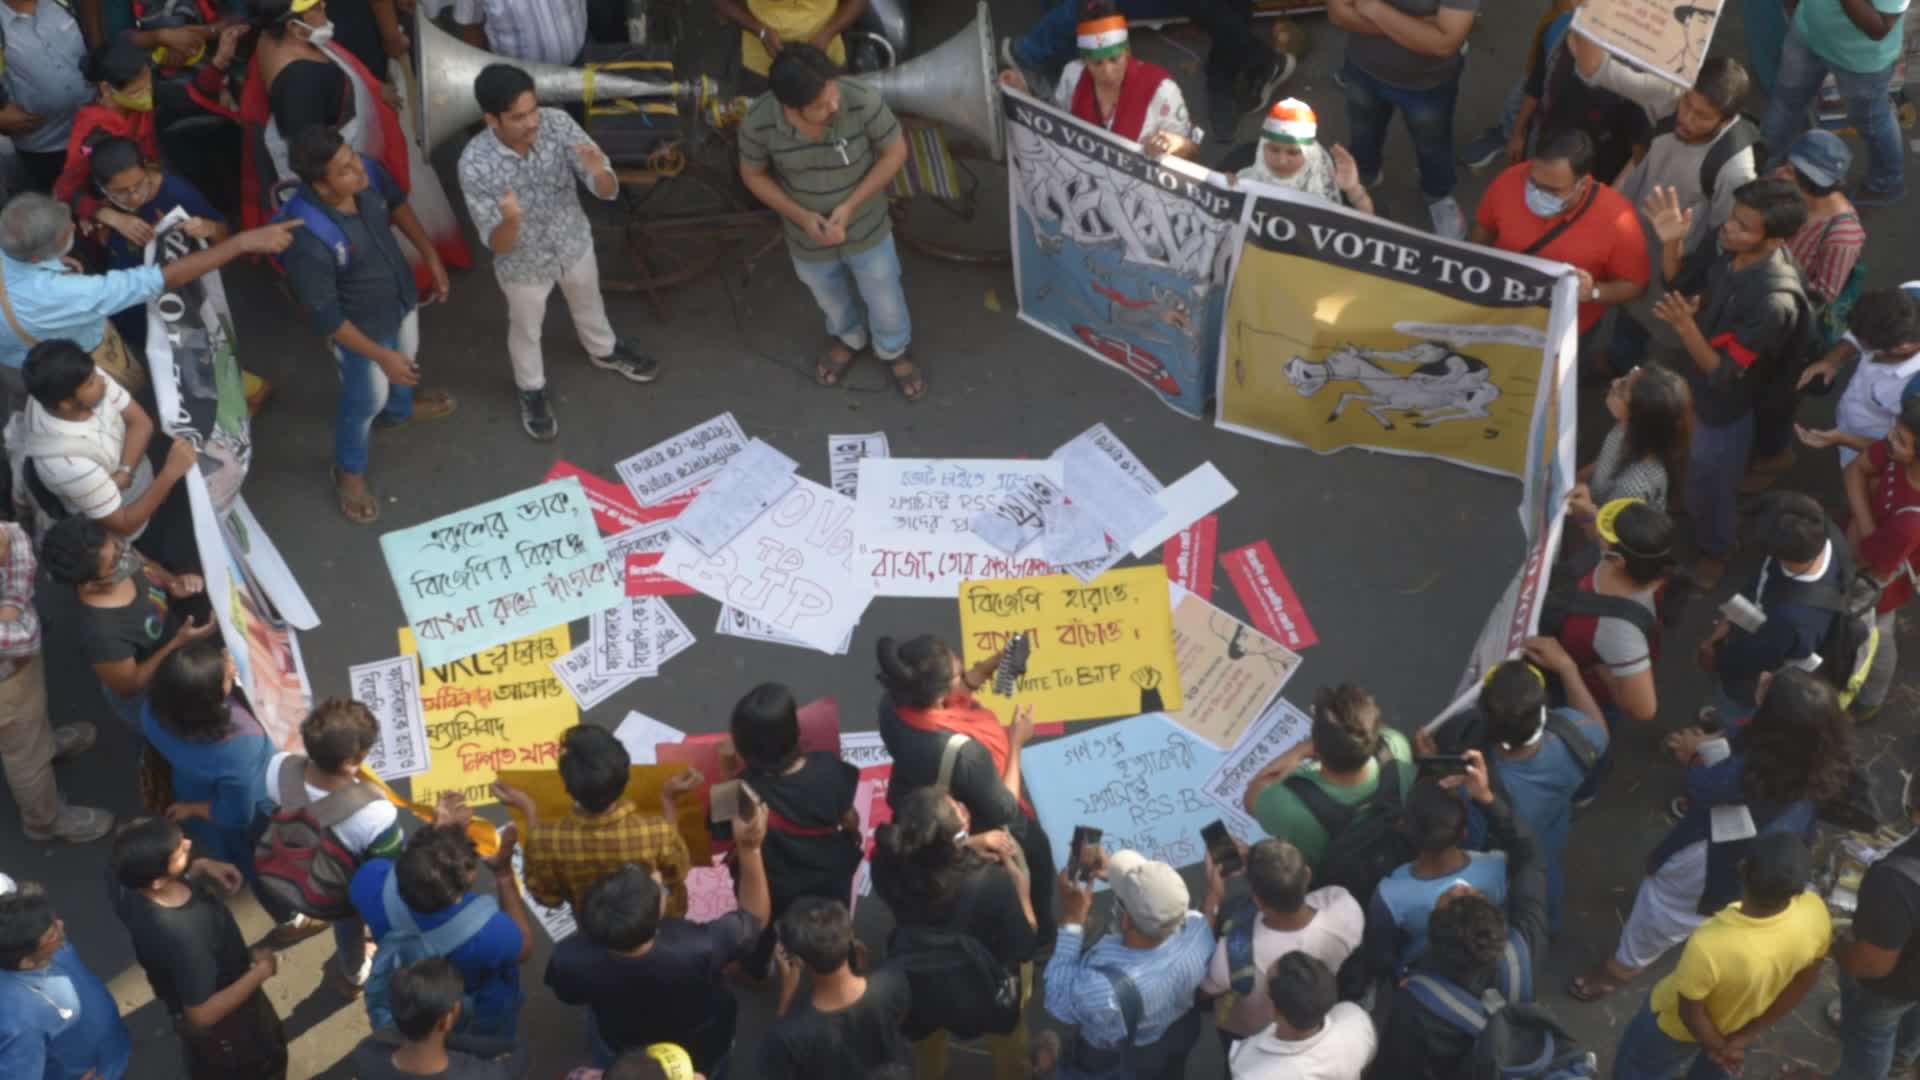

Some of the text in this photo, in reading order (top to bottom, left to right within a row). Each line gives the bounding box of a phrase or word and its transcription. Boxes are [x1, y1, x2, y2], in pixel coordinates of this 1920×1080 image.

[1016, 107, 1231, 218] NO VOTE TO BJP
[1245, 210, 1551, 304] NO VOTE TO BJ
[968, 585, 1042, 617] বিজেপি
[416, 604, 485, 641] বাংলা
[1076, 663, 1122, 686] BJP
